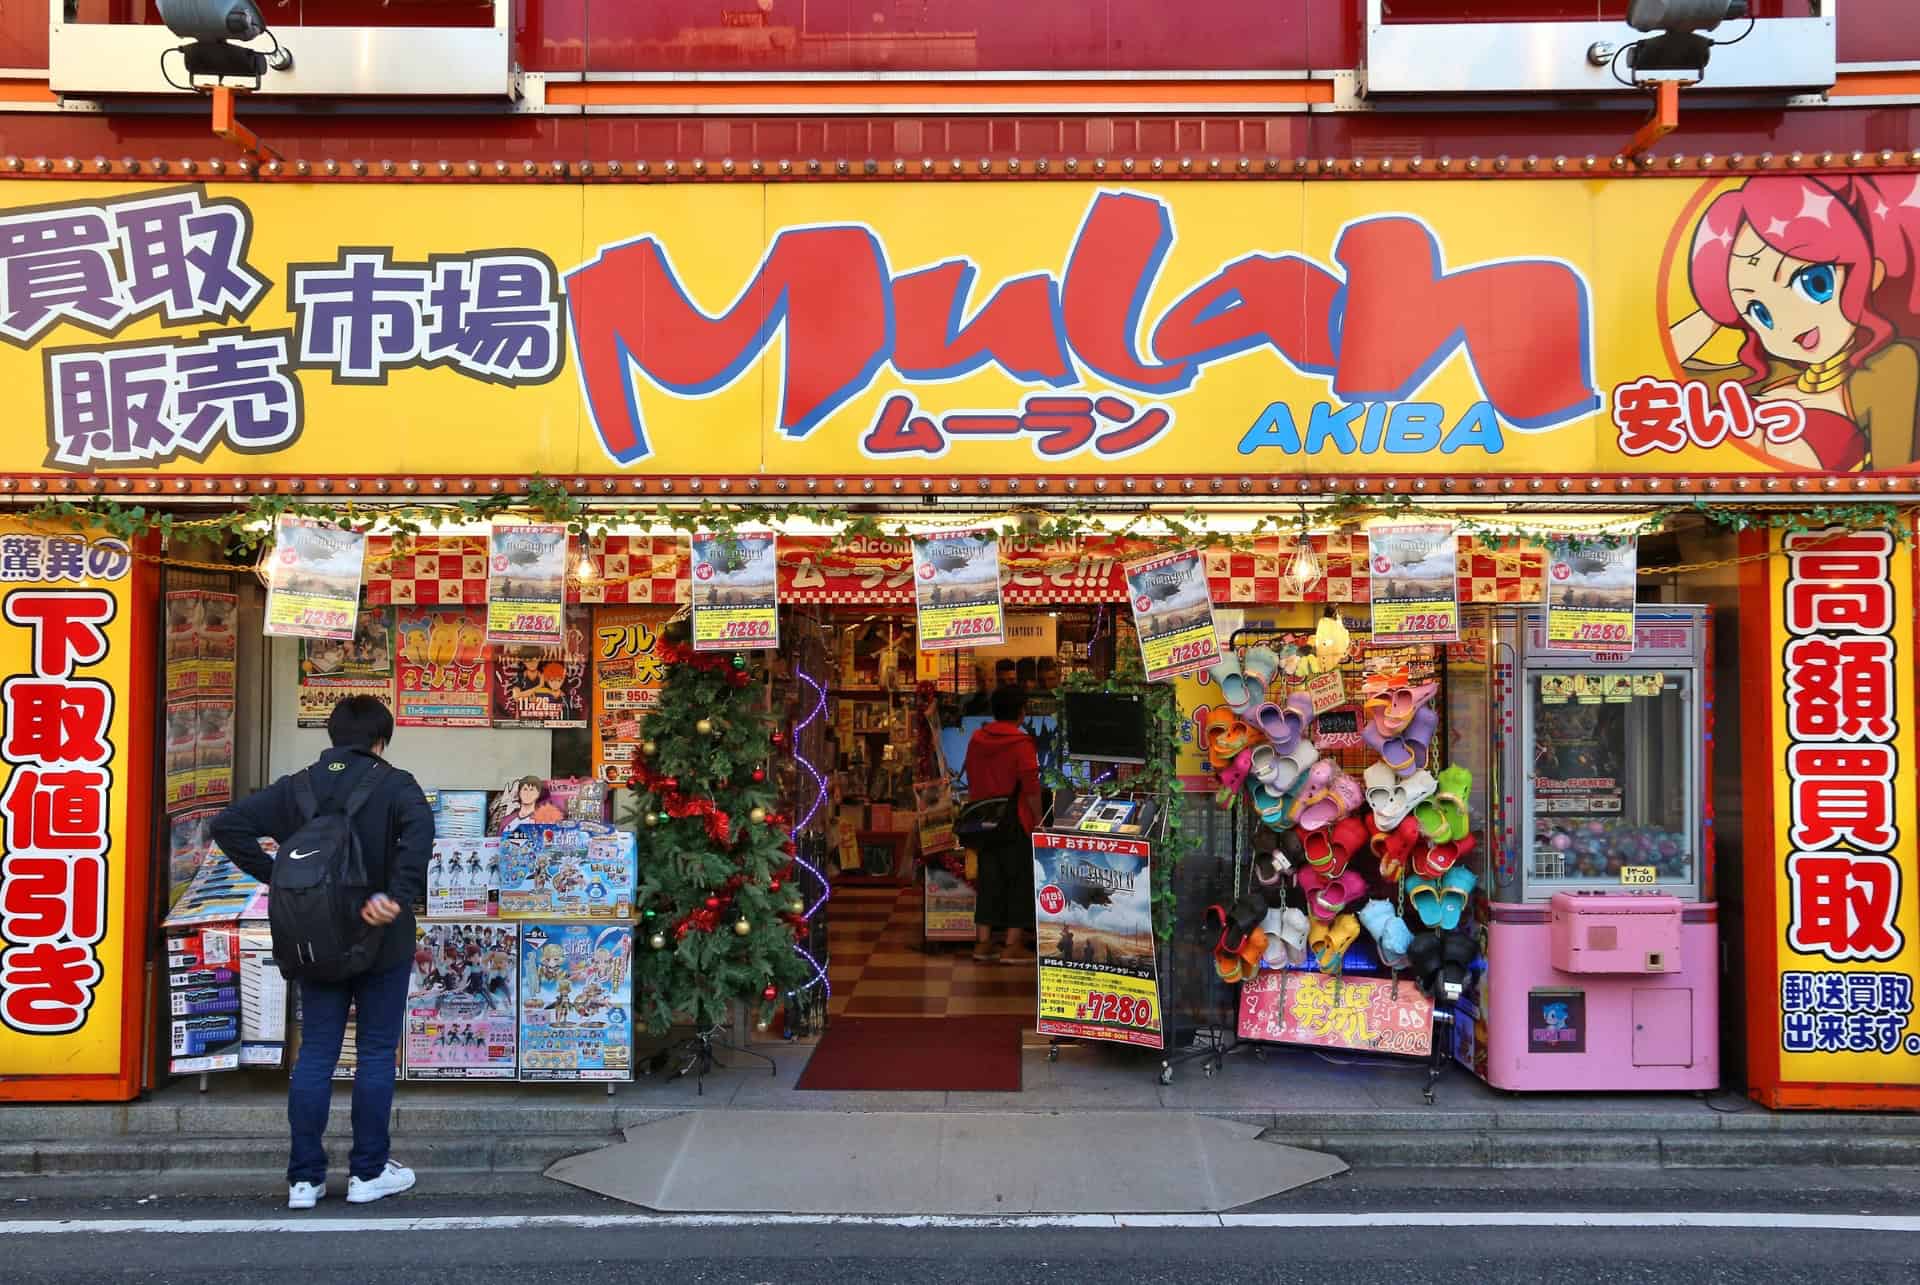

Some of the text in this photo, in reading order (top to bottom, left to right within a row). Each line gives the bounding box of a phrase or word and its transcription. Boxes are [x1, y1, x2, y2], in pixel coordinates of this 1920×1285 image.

[0, 186, 268, 345] 買取
[290, 250, 564, 384] 市場
[46, 331, 302, 469] 販売
[864, 392, 1176, 461] ムーラン
[1237, 401, 1504, 454] AKIBA
[1613, 376, 1806, 456] 安いっ
[0, 535, 131, 582] 驚異の
[1595, 653, 1624, 661] mini
[1786, 530, 1900, 960] 高額買取
[2, 591, 115, 1033] 下取値引き
[1066, 840, 1138, 854] おすすめゲーム
[1783, 973, 1913, 1012] 郵送買取
[1784, 1013, 1920, 1053] 出来ます。
